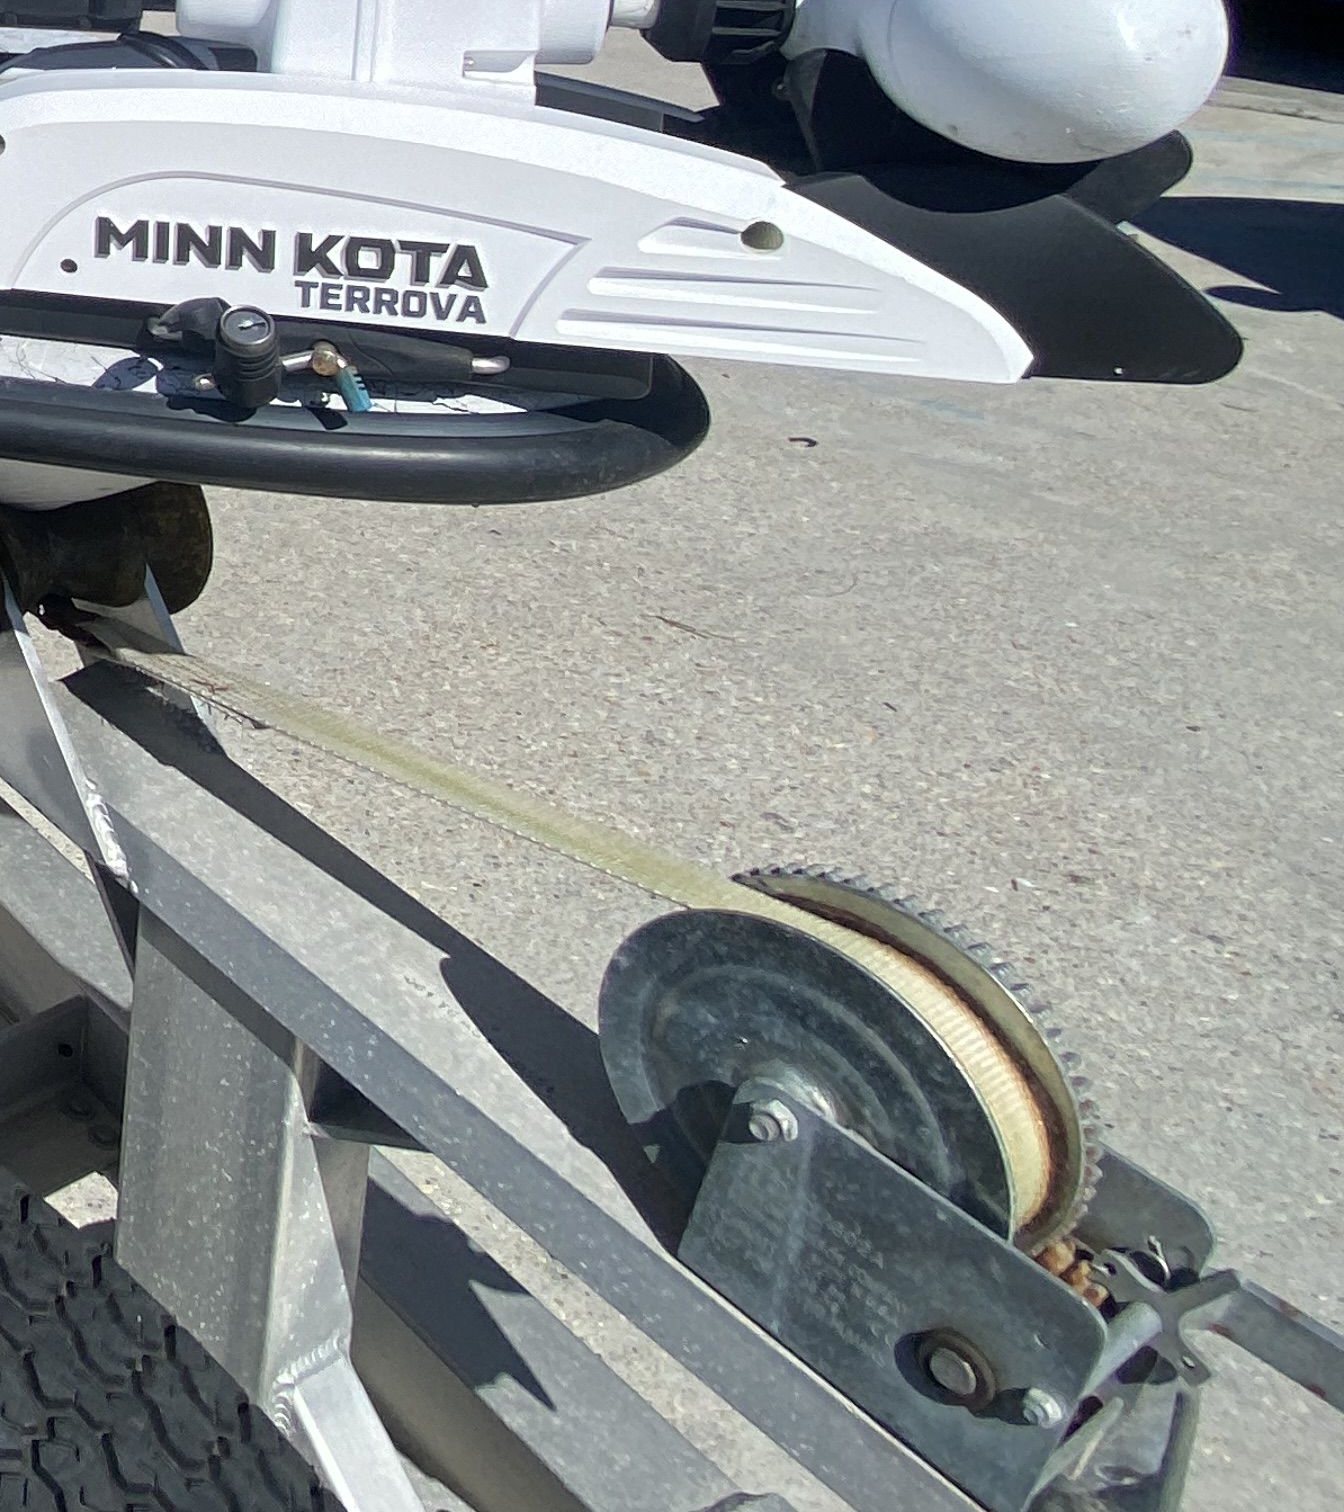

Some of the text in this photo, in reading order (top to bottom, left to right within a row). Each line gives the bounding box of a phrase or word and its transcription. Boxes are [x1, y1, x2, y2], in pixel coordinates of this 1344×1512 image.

[93, 216, 489, 291] MINN KOTA
[294, 279, 487, 324] TERROVA
